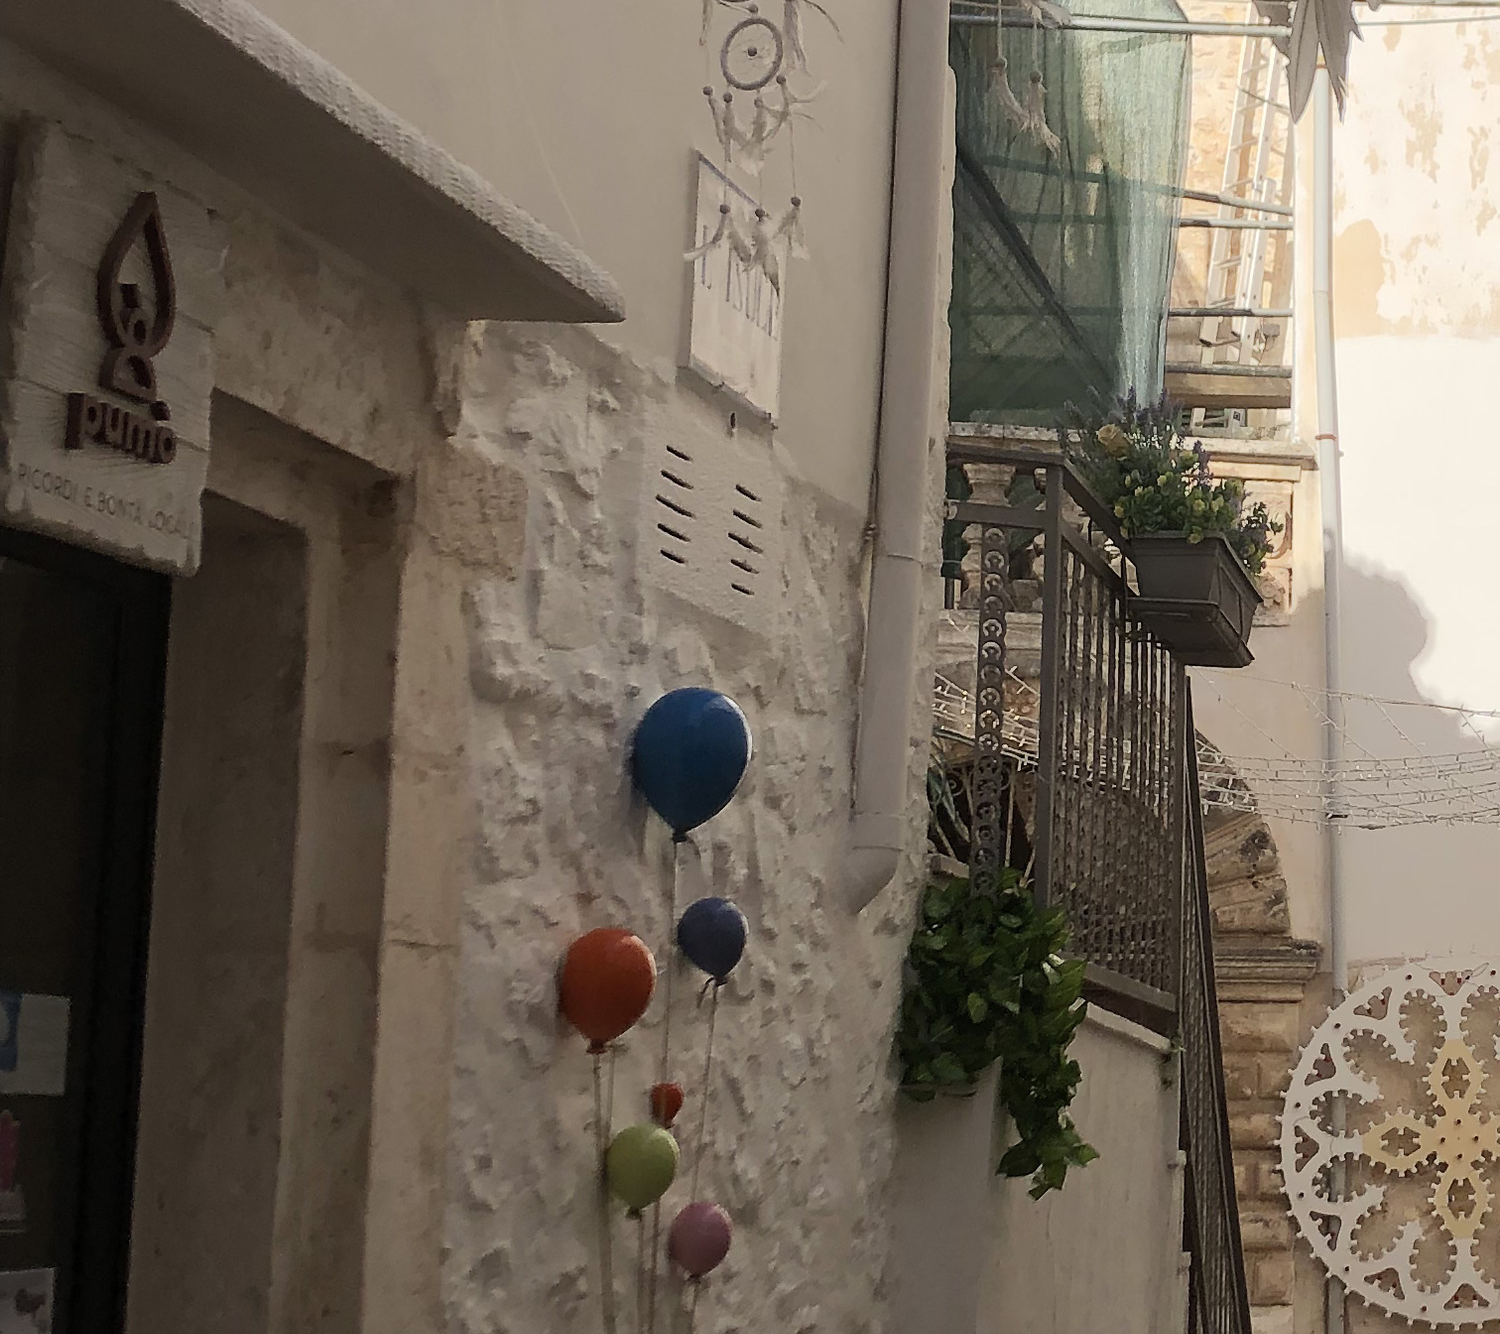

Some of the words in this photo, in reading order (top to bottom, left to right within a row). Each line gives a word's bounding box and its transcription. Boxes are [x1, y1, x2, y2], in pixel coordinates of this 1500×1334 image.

[64, 392, 177, 464] pumo
[18, 463, 78, 503] RICORDI
[83, 486, 93, 508] E
